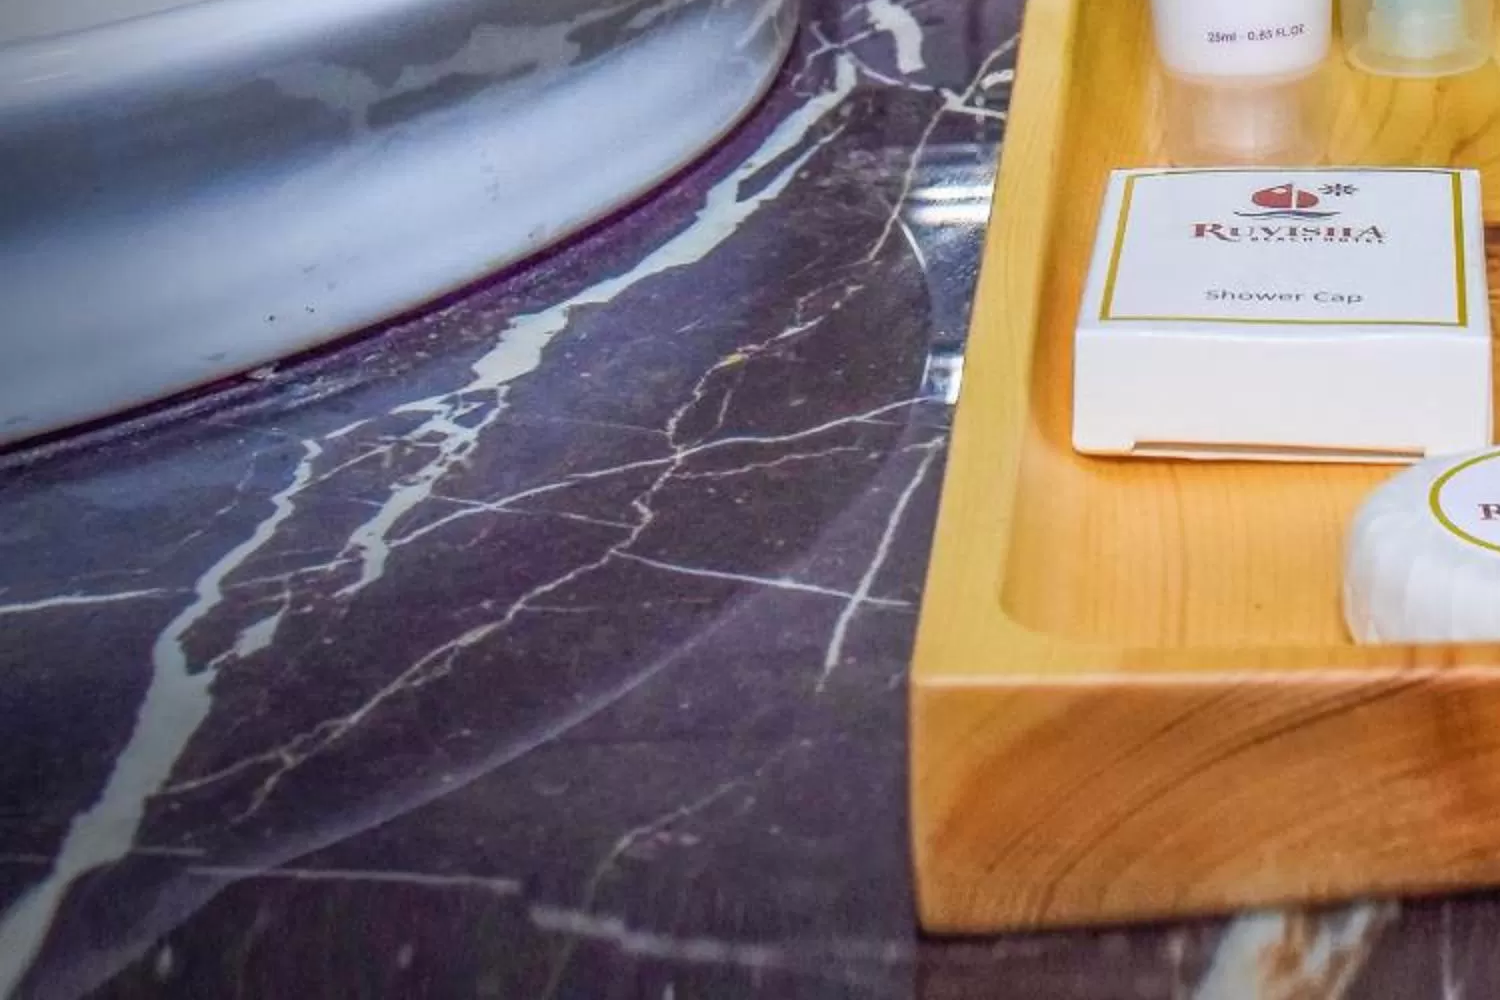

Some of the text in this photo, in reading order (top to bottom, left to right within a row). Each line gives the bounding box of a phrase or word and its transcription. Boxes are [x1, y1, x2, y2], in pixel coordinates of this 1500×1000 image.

[1191, 223, 1386, 242] RUVISHA
[1205, 288, 1363, 305] Shower Cap
